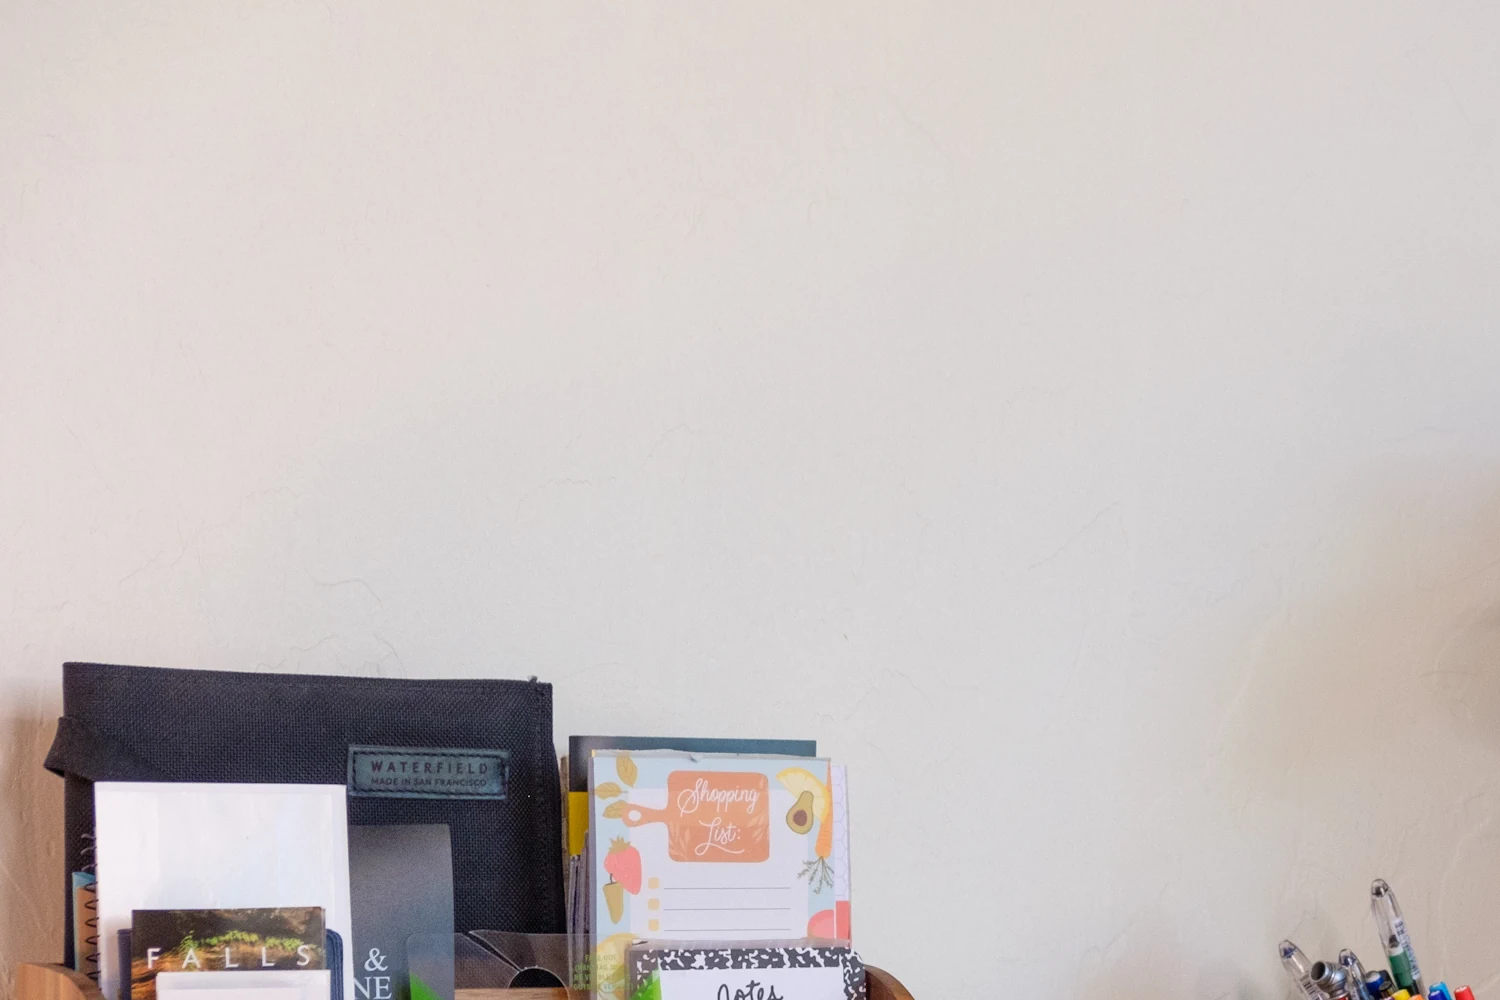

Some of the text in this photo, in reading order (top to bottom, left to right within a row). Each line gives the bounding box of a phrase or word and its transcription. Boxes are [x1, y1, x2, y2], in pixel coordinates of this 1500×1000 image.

[370, 760, 488, 774] WATERFIELD
[371, 777, 487, 787] MADE IN SAN FRANCISCO
[677, 777, 760, 818] Shopping
[695, 817, 745, 856] List:
[147, 945, 310, 969] FALLS
[364, 947, 388, 972] &
